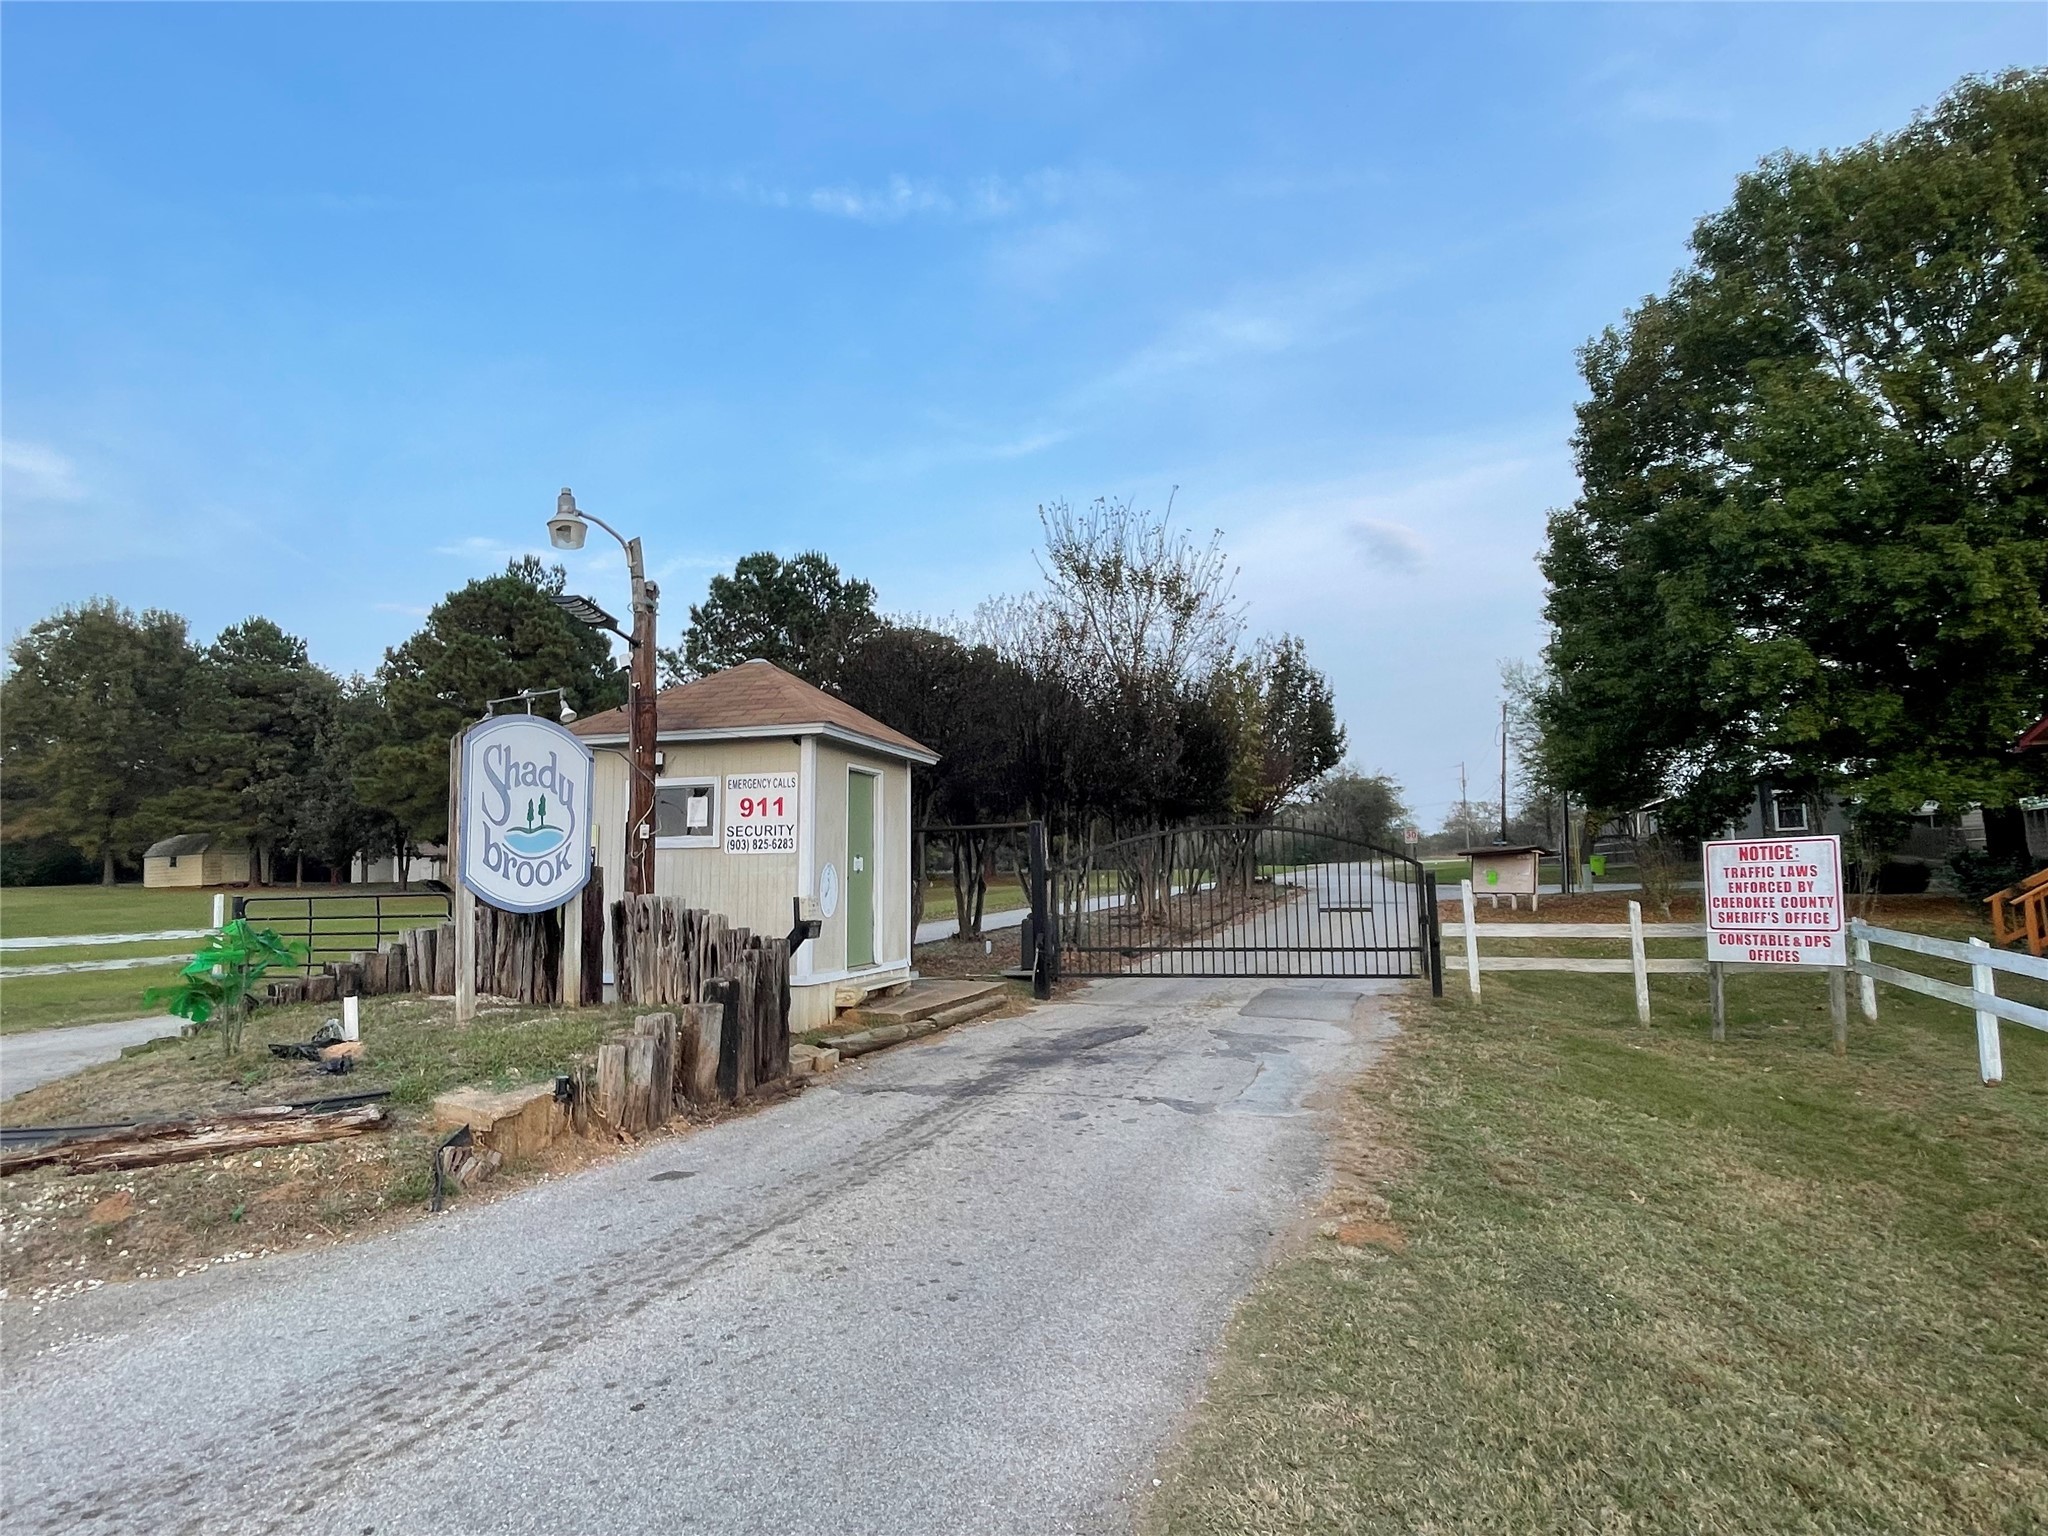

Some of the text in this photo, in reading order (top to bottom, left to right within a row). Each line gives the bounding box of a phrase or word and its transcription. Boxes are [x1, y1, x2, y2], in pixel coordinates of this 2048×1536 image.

[728, 777, 796, 790] EMERGENCY CALLS
[482, 744, 575, 852] Shady
[740, 797, 784, 818] 911
[726, 824, 795, 838] SECURITY
[726, 838, 794, 853] (903) 825-6283
[482, 820, 572, 887] brook
[1739, 845, 1800, 861] NOTICE:
[1723, 865, 1818, 878] TRAFFIC LAWS
[1728, 881, 1814, 893] ENFORCED BY
[1712, 896, 1834, 908] CHEROKEE COUNTY
[1718, 912, 1830, 924] SHERIFF'S OFFICE
[1719, 934, 1831, 947] CONSTABLE & DPS
[1749, 949, 1800, 962] OFFICES
